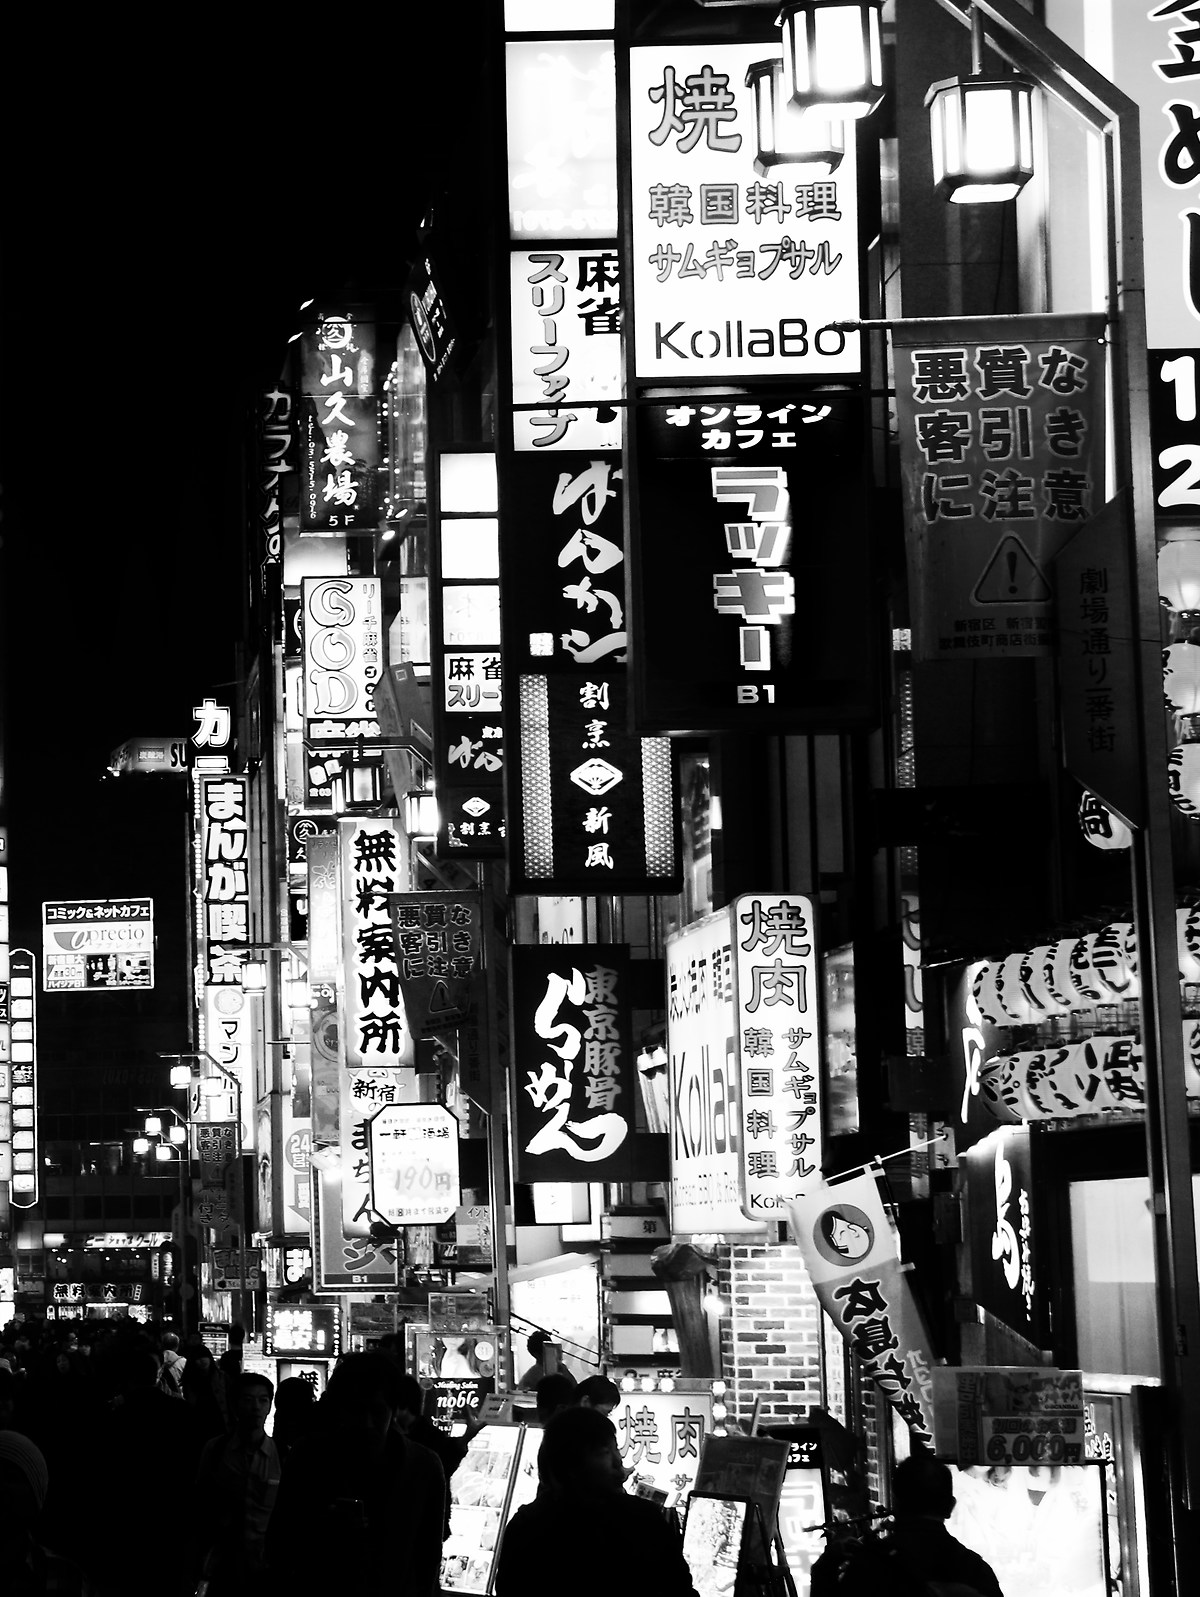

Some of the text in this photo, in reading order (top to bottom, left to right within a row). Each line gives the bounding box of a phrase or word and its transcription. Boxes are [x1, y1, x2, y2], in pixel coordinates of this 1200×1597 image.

[648, 65, 742, 153] 焼
[648, 181, 842, 227] 韓国料理
[648, 236, 842, 281] サムギョプサル
[655, 318, 846, 360] KollaBo
[912, 346, 1088, 404] 悪質な
[665, 403, 832, 427] オンライン
[701, 430, 797, 450] カフェ
[913, 407, 1086, 463] 客引き
[328, 515, 356, 527] 5F
[920, 467, 1094, 524] に注意
[711, 466, 797, 671] ラッキー
[309, 580, 358, 714] GOD
[1079, 567, 1118, 754] 劇場通り一番街
[579, 682, 610, 749] 割烹
[737, 685, 776, 705] B1
[582, 806, 614, 870] 新風
[204, 780, 248, 984] まんが喫茶
[47, 905, 150, 920] コミック&ネットカフェ
[398, 904, 471, 928] 悪質な
[353, 830, 402, 1054] 無料案内所
[400, 931, 471, 955] 客引き
[403, 957, 473, 980] に注意
[741, 900, 811, 1014] 焼肉
[583, 964, 623, 1111] 東京豚骨
[352, 1079, 397, 1103] 新宿
[743, 1027, 780, 1178] 韓国料理
[781, 1027, 817, 1178] サムギョプサル
[352, 1274, 368, 1284] B1
[436, 1390, 480, 1409] noble
[618, 1404, 704, 1465] 焼肉
